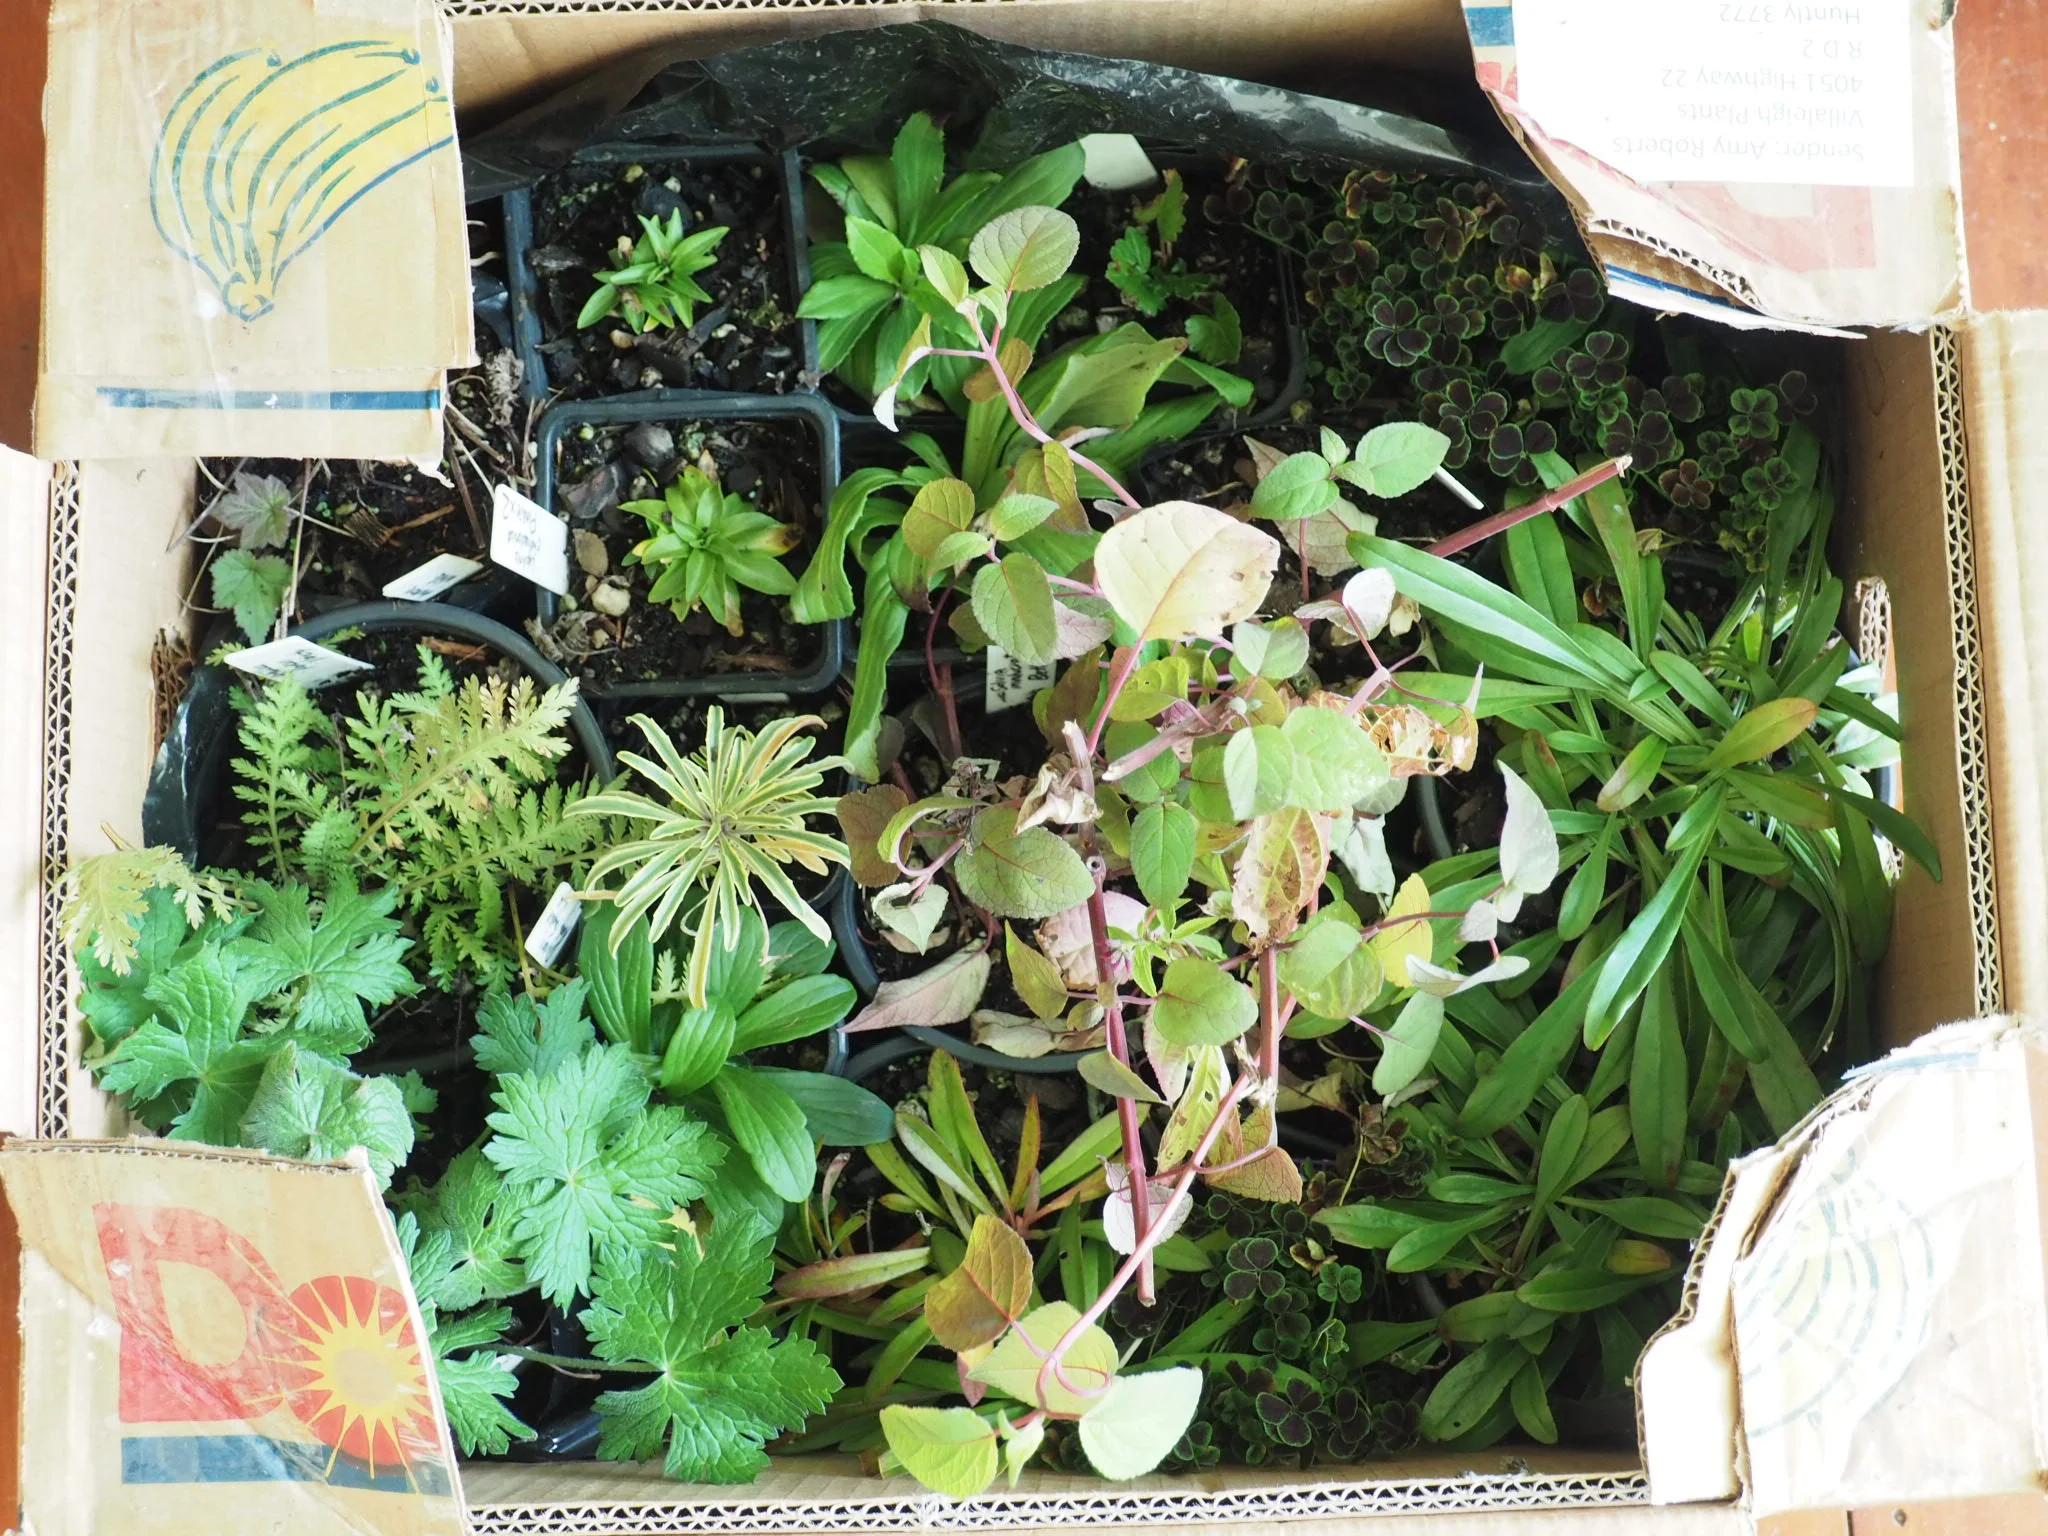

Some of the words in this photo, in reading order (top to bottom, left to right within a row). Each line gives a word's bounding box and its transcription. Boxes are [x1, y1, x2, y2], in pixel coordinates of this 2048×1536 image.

[1719, 3, 1776, 23] 3772
[1783, 1, 1860, 24] Huntly
[1802, 39, 1814, 57] 2
[1823, 40, 1838, 58] D
[1848, 40, 1862, 59] R
[1661, 68, 1688, 88] 22
[1696, 65, 1796, 91] Highway
[1807, 73, 1863, 93] 4051
[1678, 103, 1749, 125] Plants
[1757, 102, 1864, 128] Villaleigh
[1612, 136, 1704, 159] Roberts
[1712, 136, 1766, 159] Amy
[1775, 140, 1864, 161] Sender:
